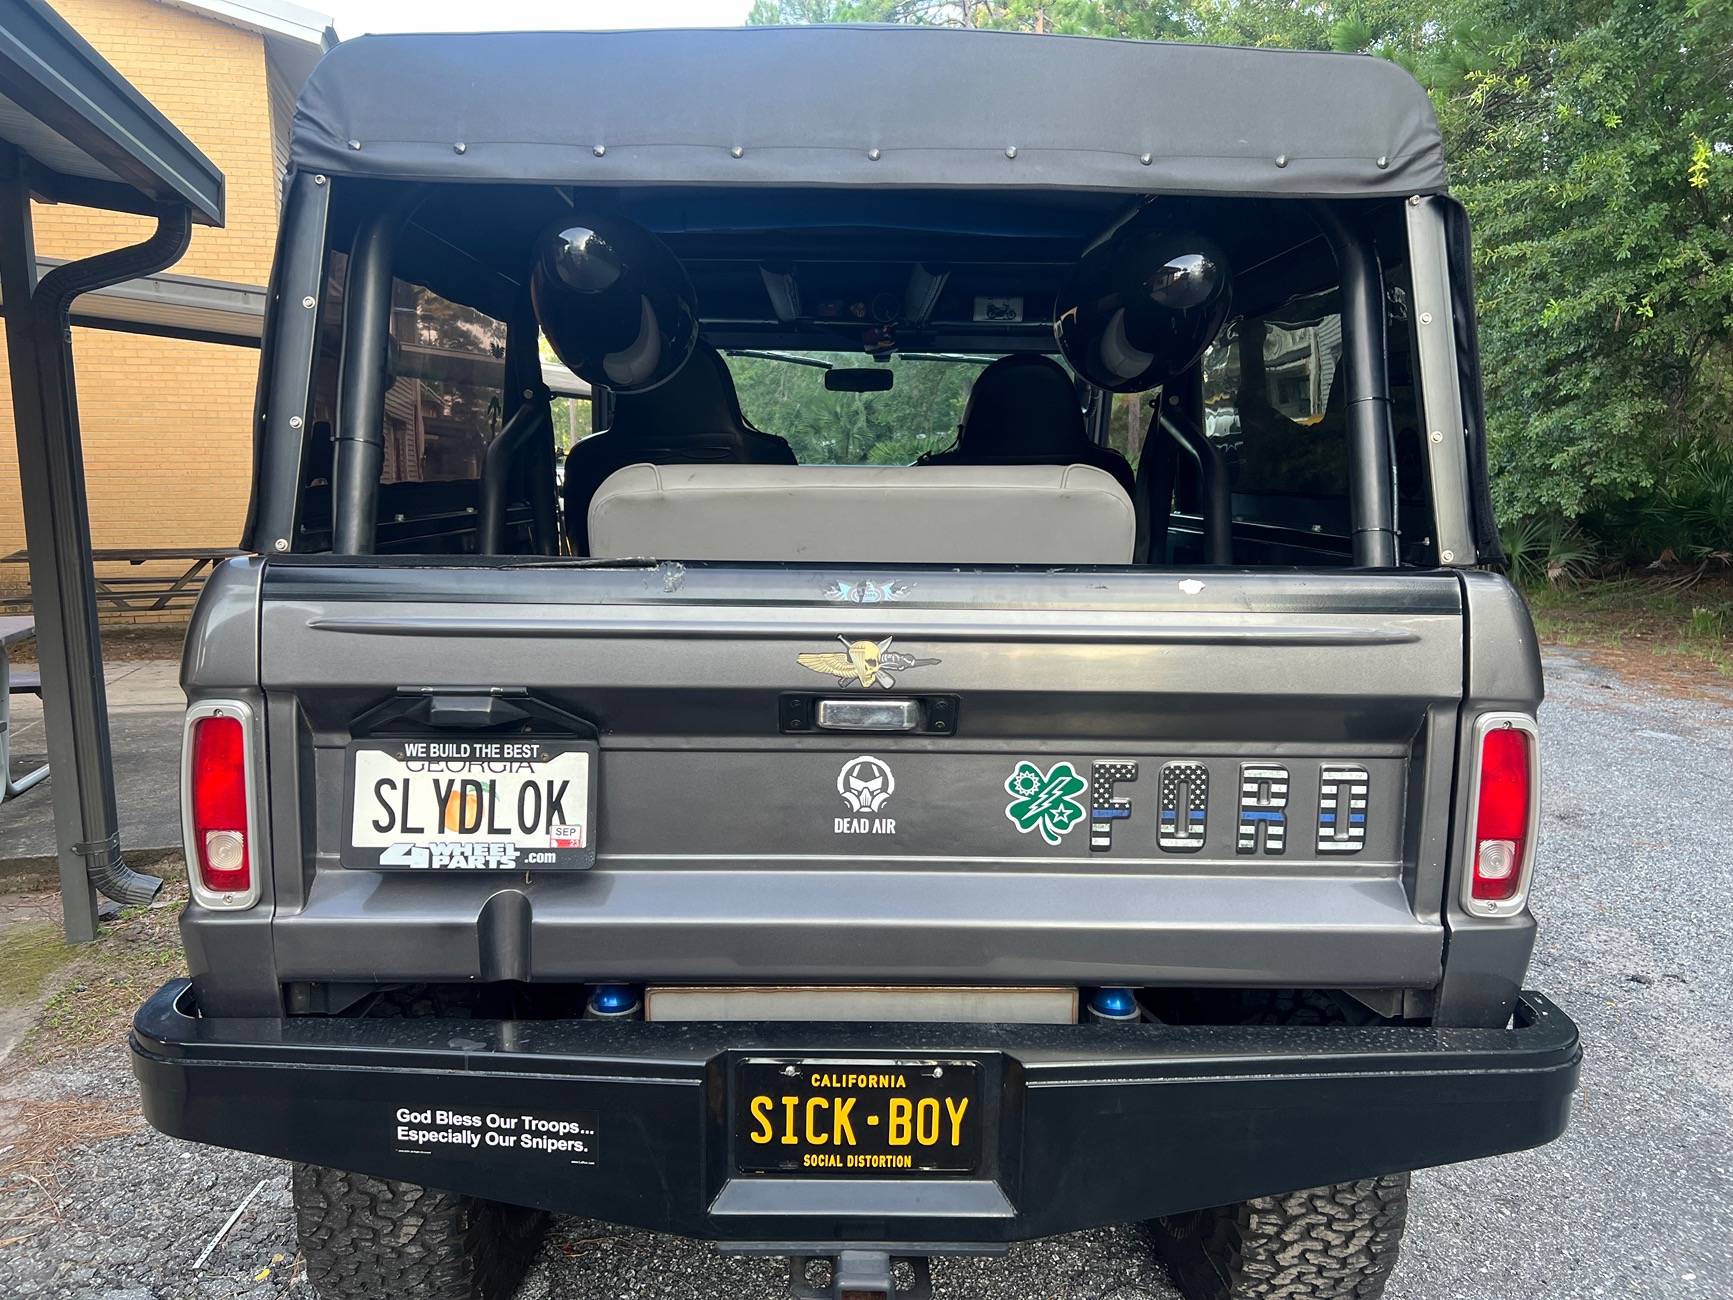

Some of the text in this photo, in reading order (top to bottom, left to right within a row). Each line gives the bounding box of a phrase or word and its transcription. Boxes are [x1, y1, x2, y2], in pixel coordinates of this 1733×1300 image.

[404, 743, 540, 758] WE BUILD THE BEST
[372, 777, 570, 835] SLYDLOK
[1089, 759, 1370, 855] FORD
[555, 827, 577, 837] SEP
[834, 817, 896, 834] DEAD AIR
[429, 842, 521, 856] WHEEL
[431, 852, 557, 869] PARTS .com
[810, 1074, 907, 1089] CALIFORNIA
[396, 1108, 595, 1136] God Bless Our Troops...
[396, 1126, 589, 1152] Especially Our Snipers.
[803, 1154, 912, 1168] SOCIAL DISTORTION
